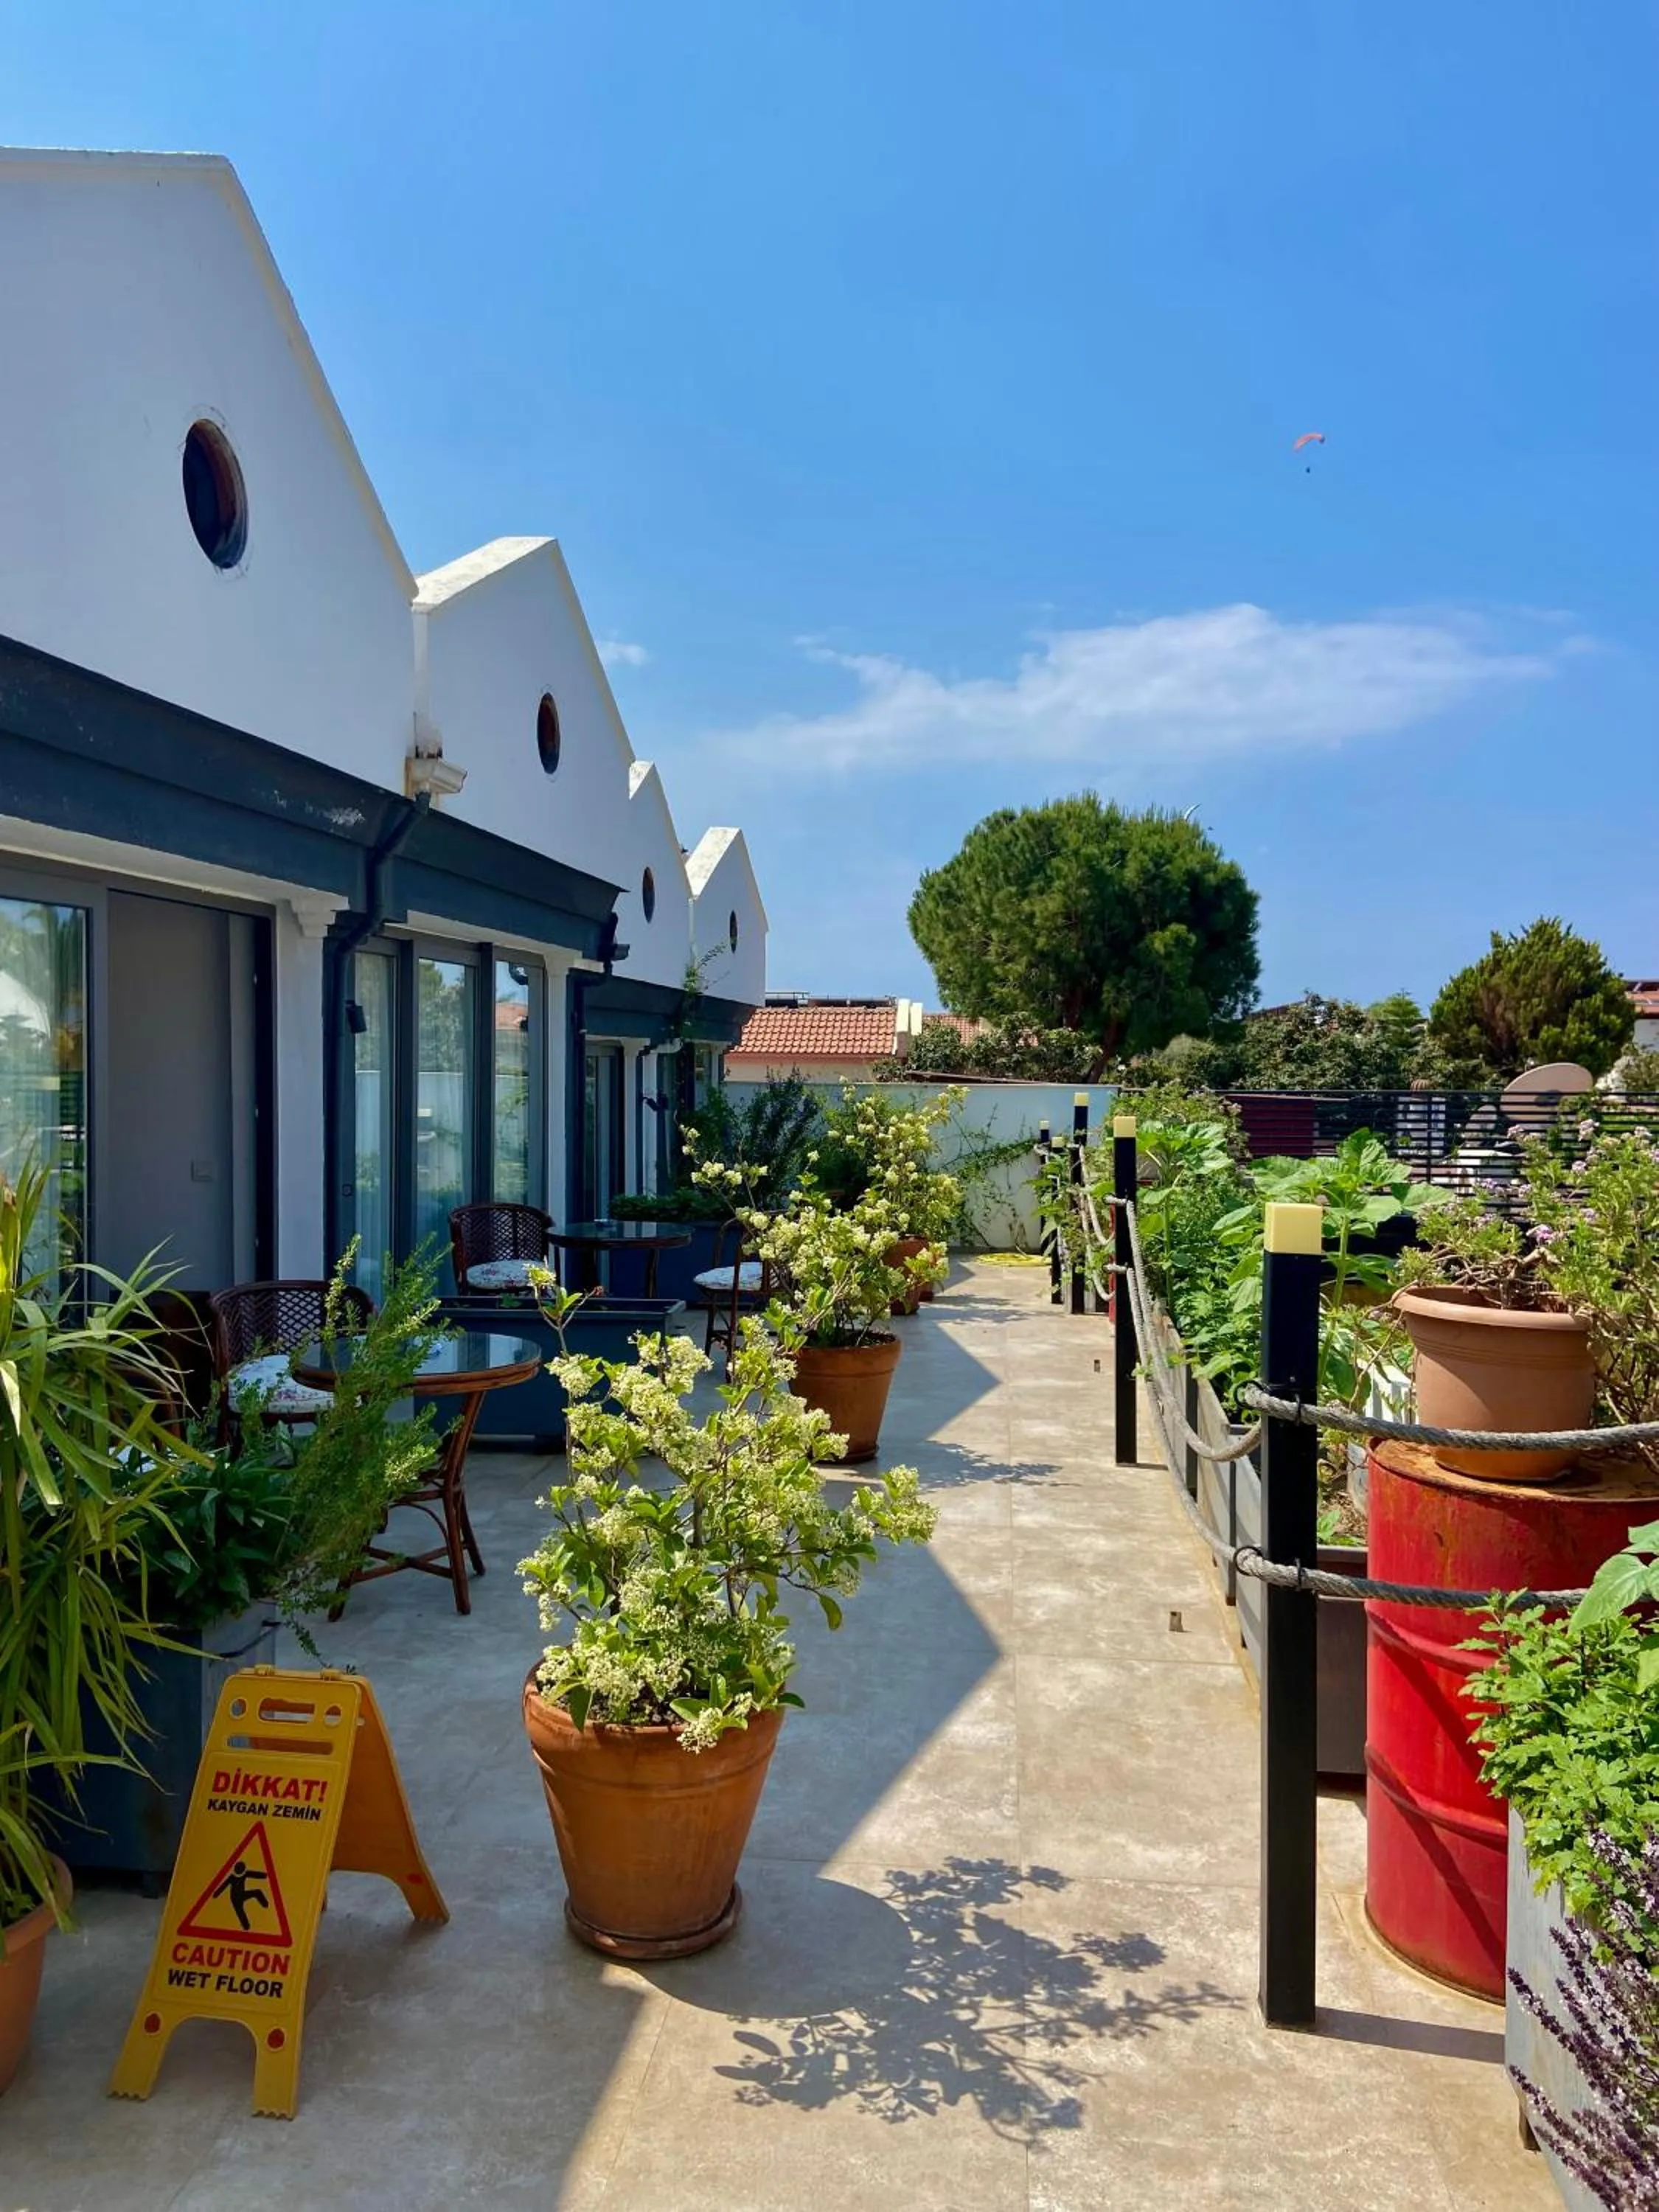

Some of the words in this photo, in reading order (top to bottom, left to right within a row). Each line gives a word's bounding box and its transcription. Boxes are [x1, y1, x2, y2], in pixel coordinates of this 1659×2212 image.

[212, 1768, 327, 1802] DİKKAT!
[207, 1799, 268, 1816] KAYGAN
[272, 1803, 321, 1820] ZEMİN
[172, 1943, 291, 1975] CAUTION
[167, 1970, 212, 1987] WET
[215, 1975, 282, 1997] FLOOR
